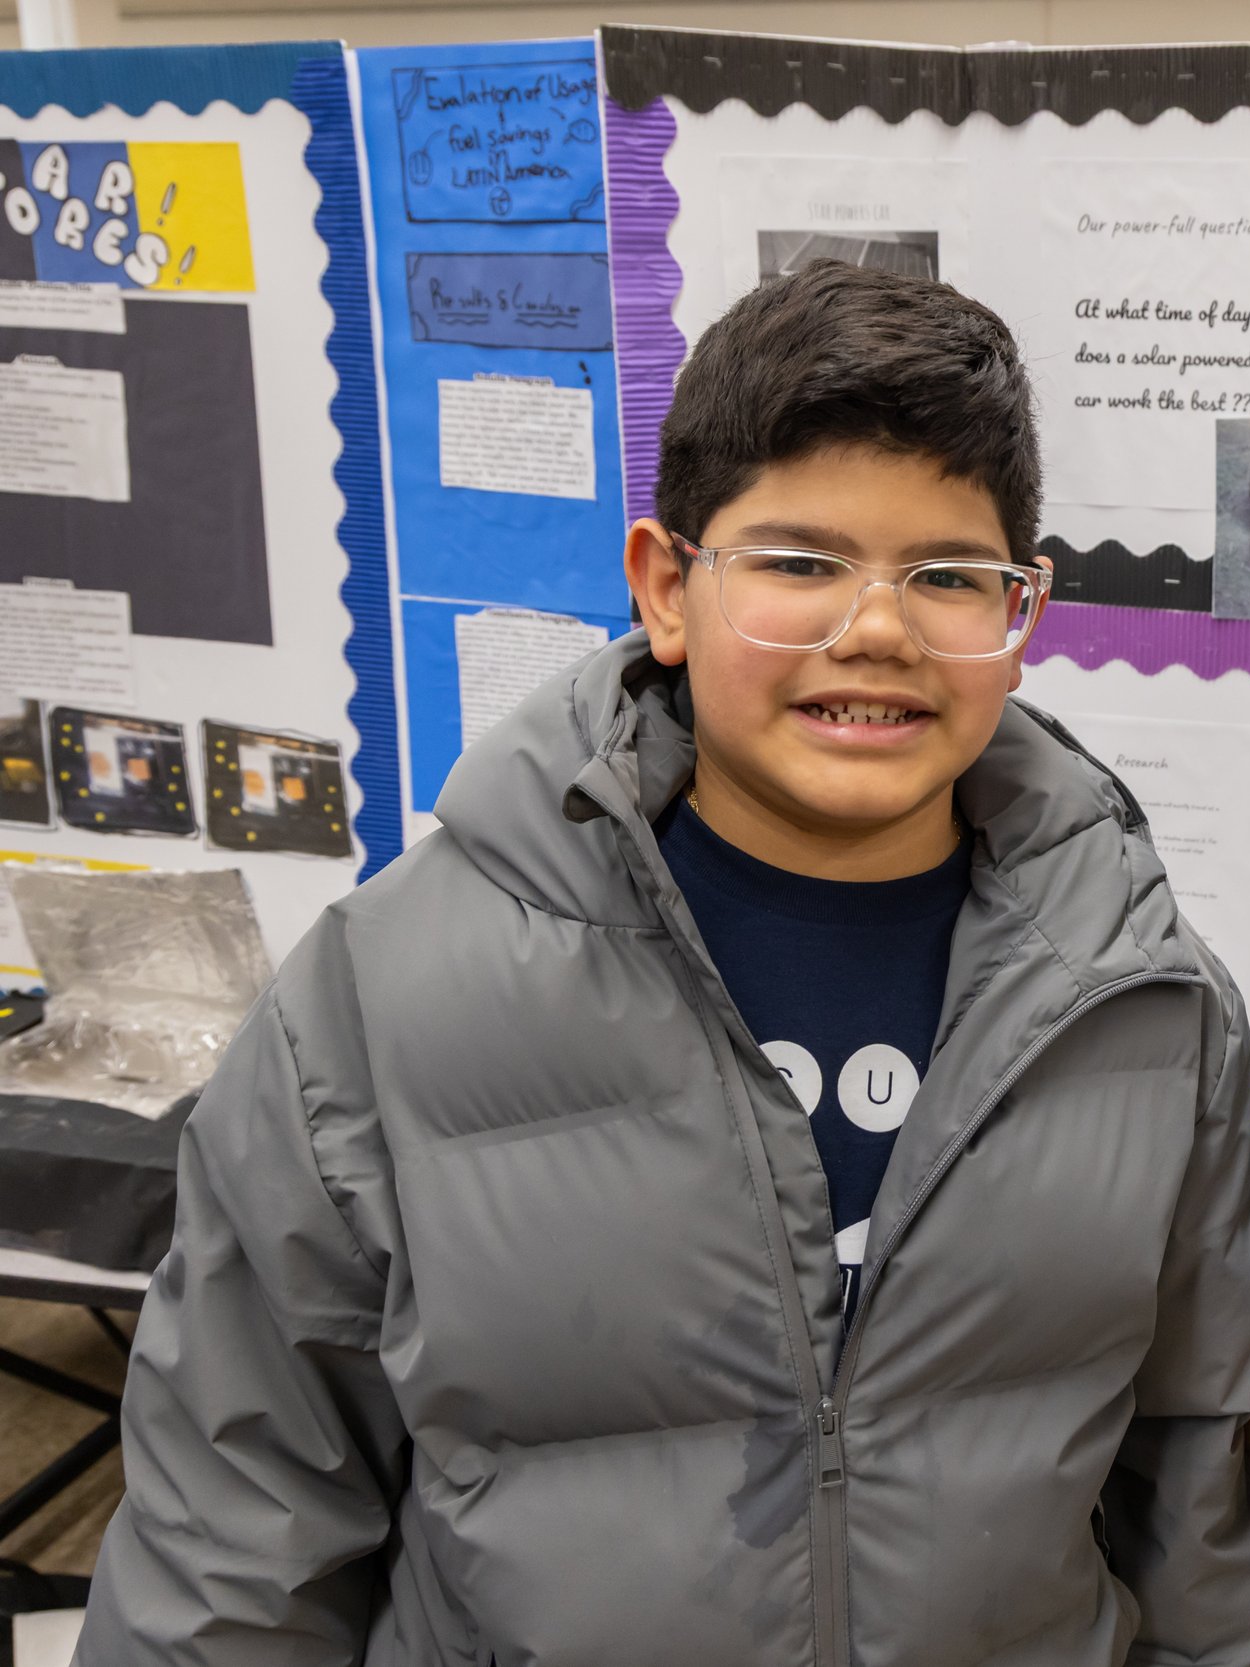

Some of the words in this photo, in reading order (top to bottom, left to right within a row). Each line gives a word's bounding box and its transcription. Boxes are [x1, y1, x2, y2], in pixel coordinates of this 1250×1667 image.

[1077, 213, 1107, 234] Our
[1112, 214, 1196, 238] power-full
[1075, 299, 1101, 319] At
[1105, 297, 1150, 320] what
[1155, 300, 1192, 321] time
[1199, 300, 1218, 328] of
[1222, 300, 1250, 332] day
[1074, 342, 1111, 364] does
[1117, 353, 1126, 364] a
[1132, 344, 1176, 366] solar
[1074, 395, 1102, 408] car
[1108, 388, 1151, 409] work
[1157, 389, 1185, 411] the
[1191, 390, 1227, 412] best
[1114, 753, 1169, 770] Research
